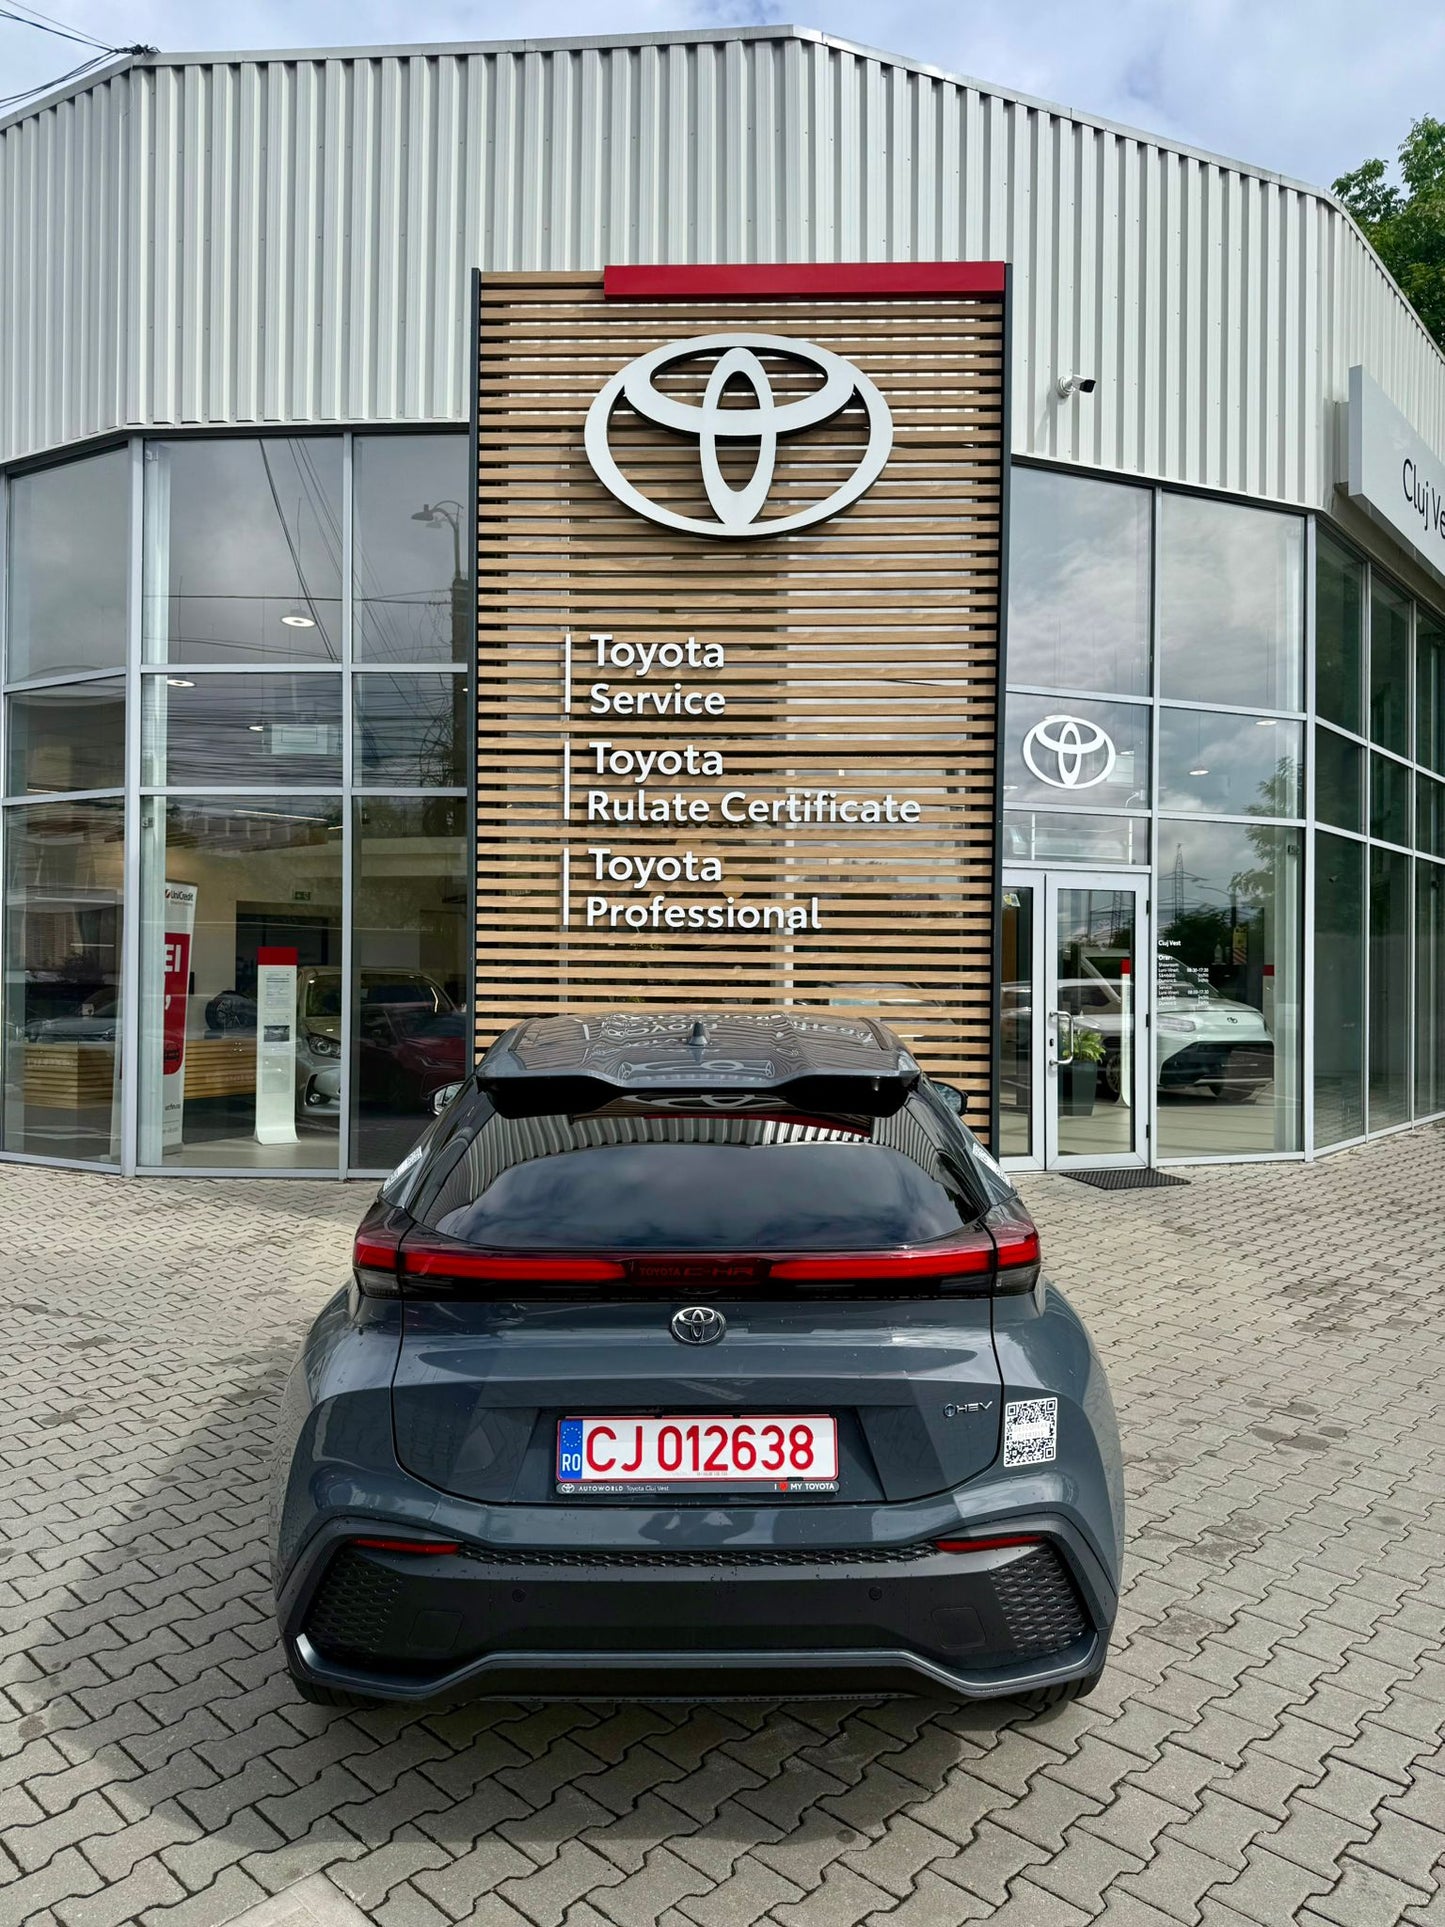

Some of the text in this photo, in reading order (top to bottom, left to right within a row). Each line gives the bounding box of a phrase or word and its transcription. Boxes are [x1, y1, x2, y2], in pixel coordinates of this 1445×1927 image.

[1403, 458, 1429, 531] Cluj
[590, 634, 725, 676] Toyota
[589, 683, 726, 715] Service
[588, 742, 723, 783] Toyota
[587, 790, 921, 823] Rulate Certificate
[588, 848, 722, 889] Toyota
[586, 896, 822, 929] Professional
[1158, 939, 1169, 947] Cluj
[640, 1267, 754, 1277] TOYOTA C-HR
[956, 1400, 993, 1413] HEV
[562, 1453, 581, 1472] RO
[586, 1424, 815, 1472] CJ 012638
[626, 1485, 644, 1493] Toyota
[645, 1485, 656, 1493] Cluj
